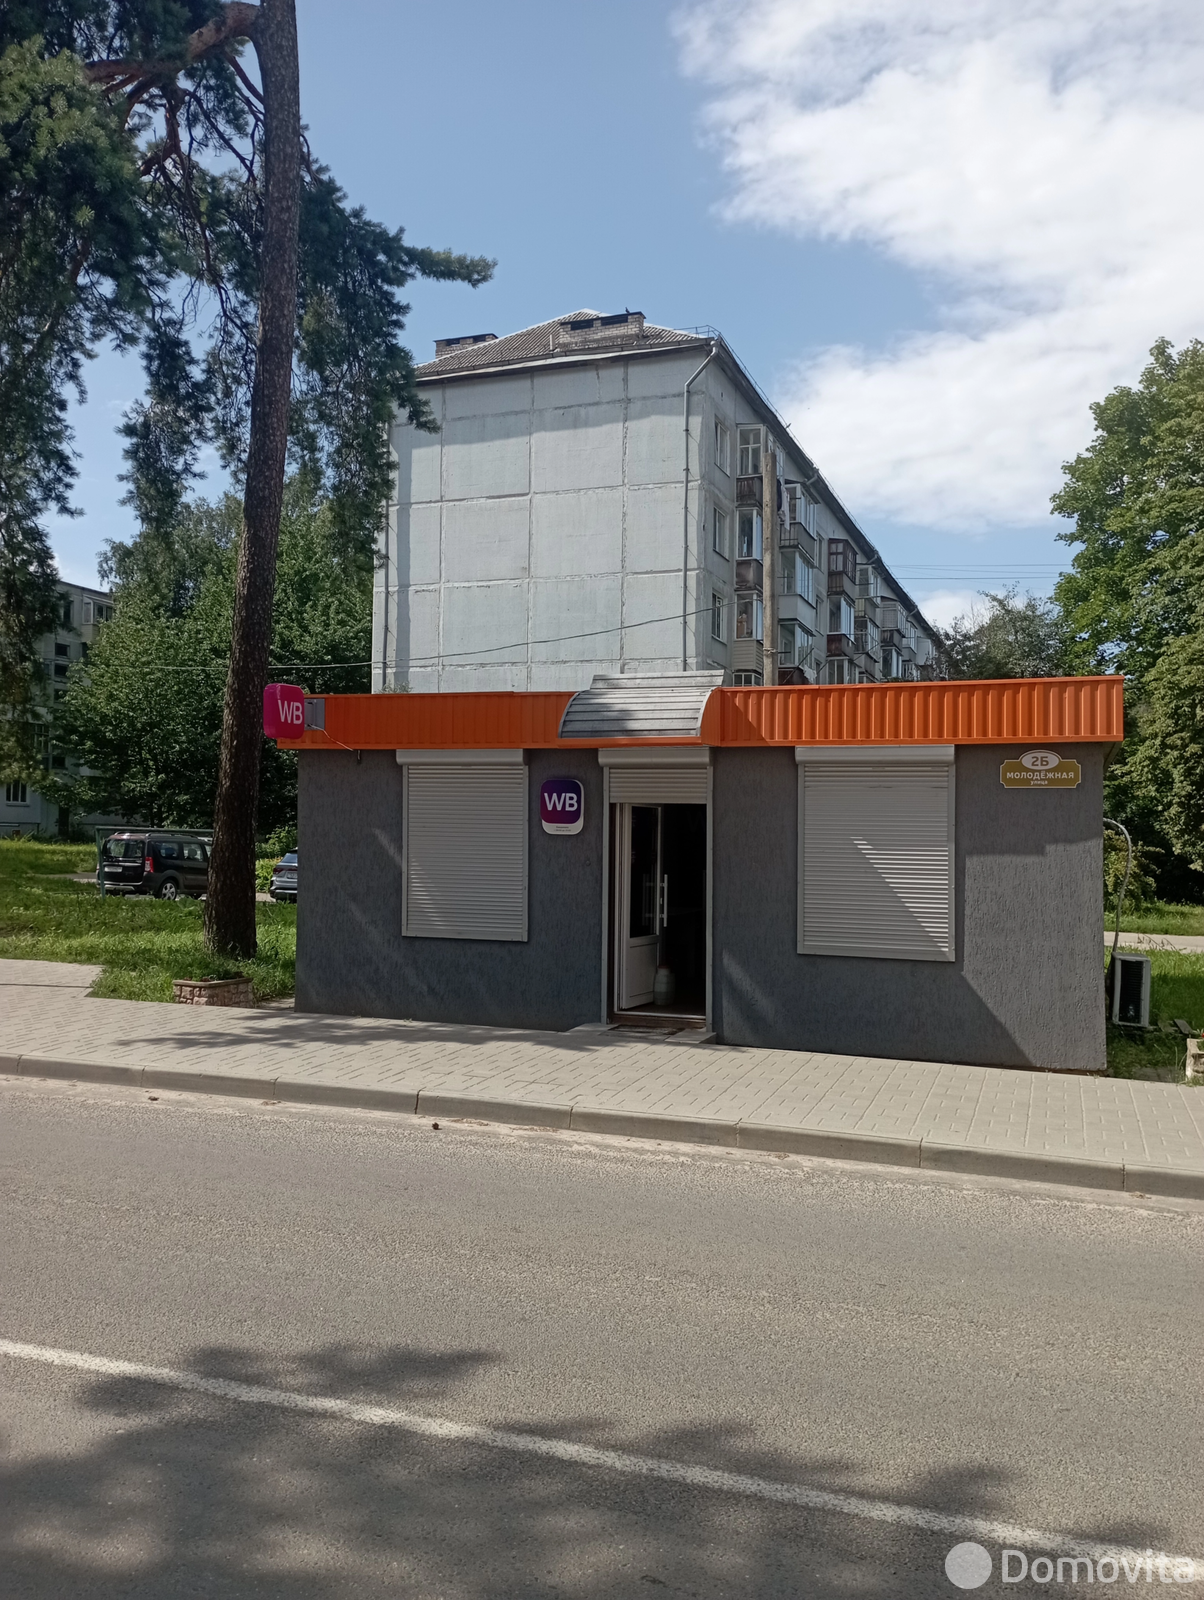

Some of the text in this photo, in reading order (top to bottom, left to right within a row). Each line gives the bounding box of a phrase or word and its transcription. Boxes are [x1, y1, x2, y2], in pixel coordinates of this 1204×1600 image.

[278, 699, 303, 725] WB
[1031, 756, 1050, 767] 2Б
[1006, 770, 1075, 780] МОЛОДЁЖНАЯ
[543, 792, 578, 811] WB
